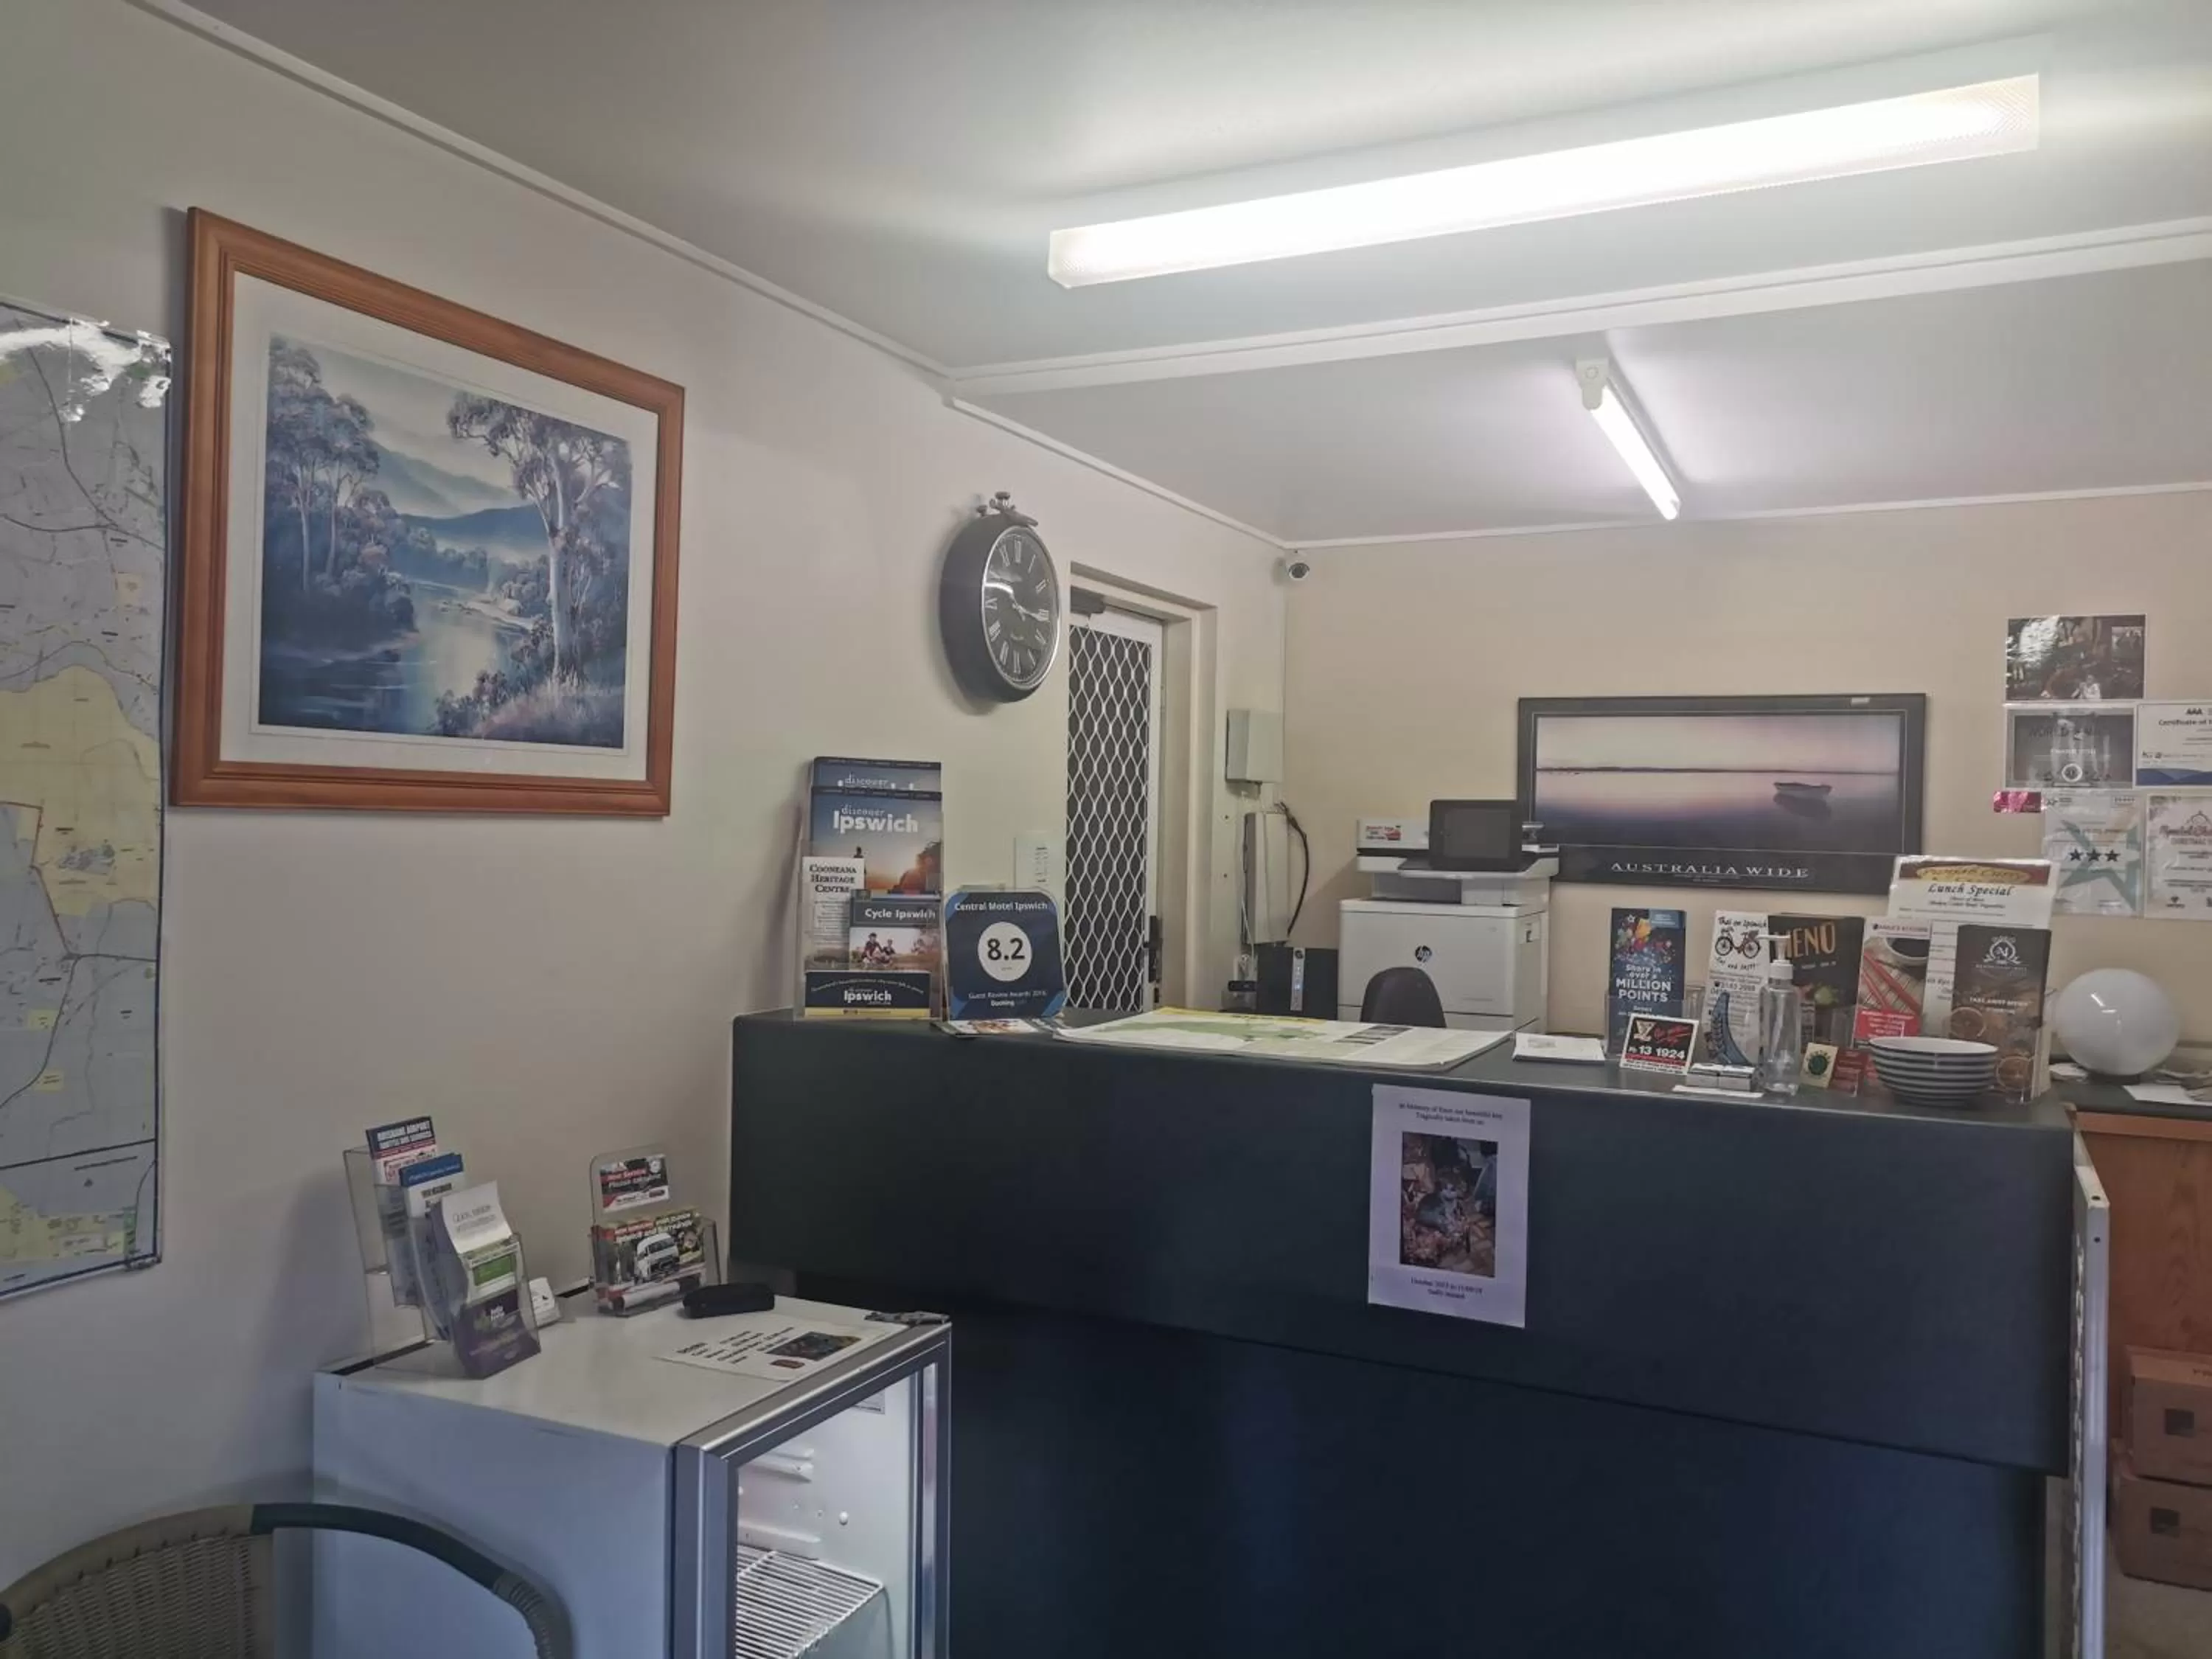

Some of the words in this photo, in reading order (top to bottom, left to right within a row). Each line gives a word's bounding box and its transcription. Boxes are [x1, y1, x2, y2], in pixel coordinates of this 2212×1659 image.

[833, 810, 918, 834] Ipswich
[1611, 862, 1738, 875] AUSTRALIA
[1745, 866, 1809, 878] WIDE
[811, 874, 855, 884] HERITAGE
[1927, 883, 1964, 894] Lunch
[1969, 883, 2014, 897] Special
[865, 908, 893, 919] Cycle
[896, 908, 936, 921] Ipswich
[955, 902, 987, 911] Central
[989, 902, 1013, 911] Motel
[1015, 902, 1048, 914] Ipswich
[987, 937, 1026, 961] 8.2
[1625, 964, 1652, 973] Share
[1629, 972, 1650, 980] over
[1615, 978, 1672, 992] MILLION
[844, 990, 892, 1004] Ipswich
[1618, 989, 1669, 1003] POINTS
[1638, 1045, 1652, 1055] 13
